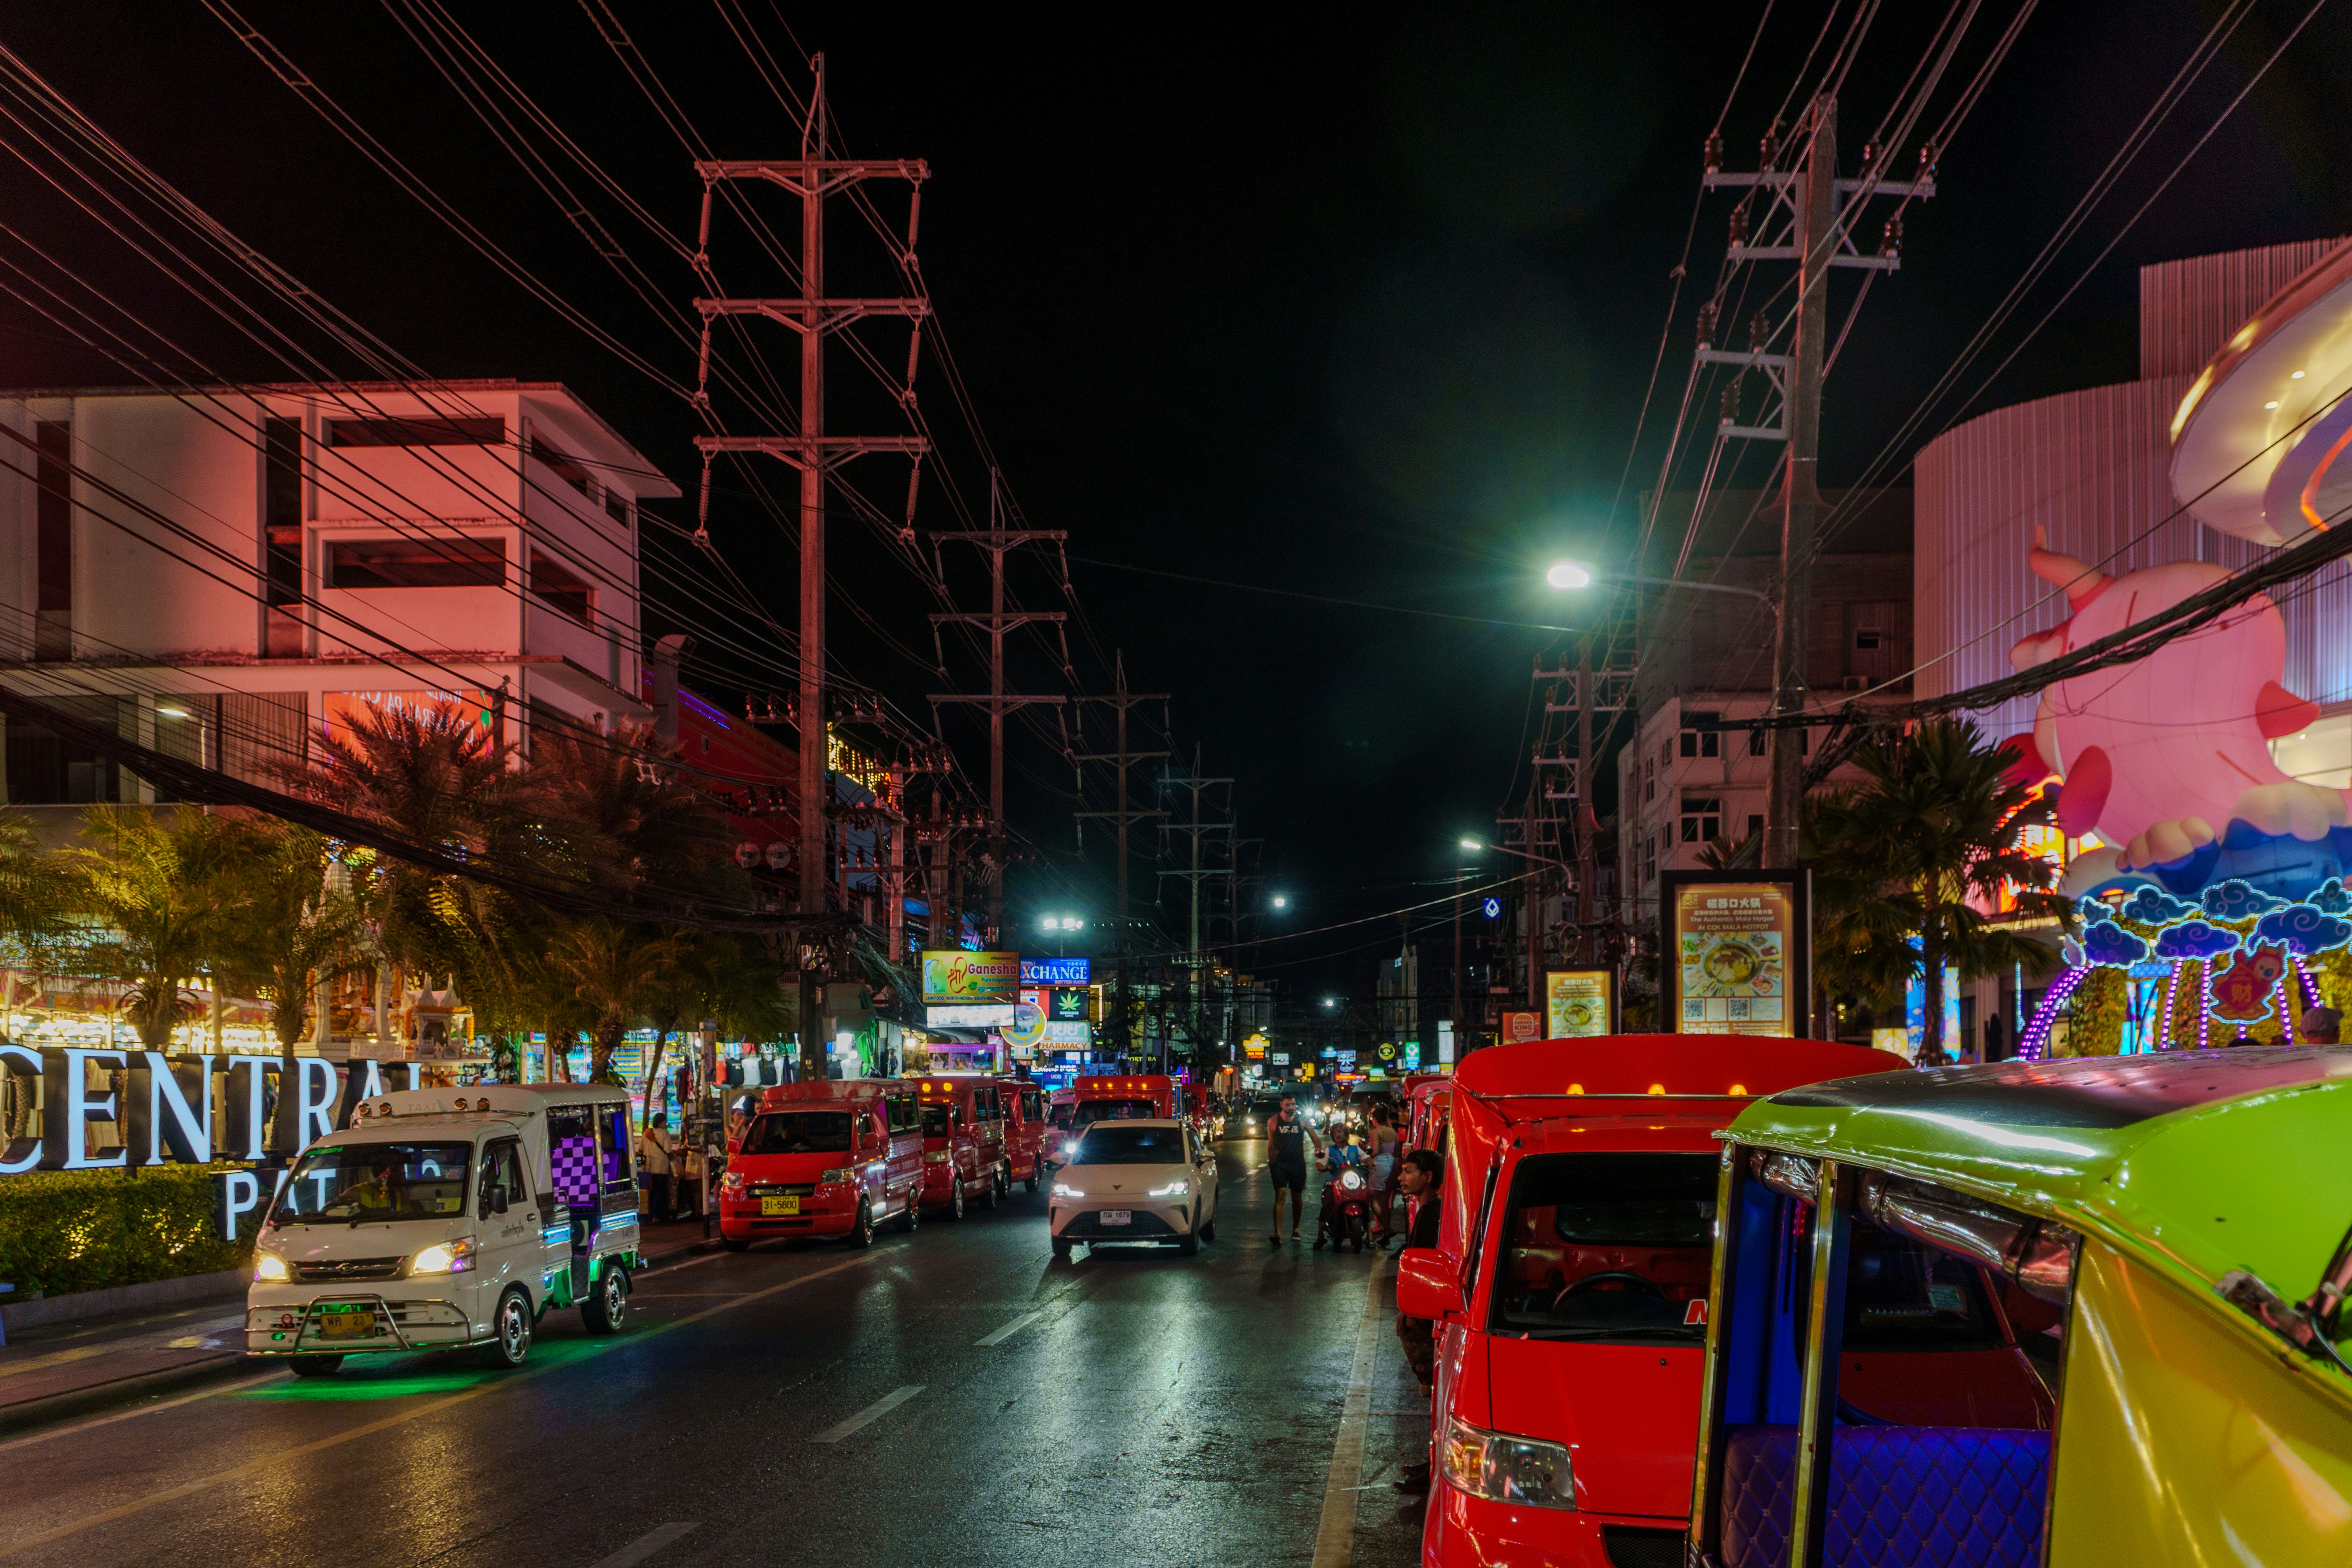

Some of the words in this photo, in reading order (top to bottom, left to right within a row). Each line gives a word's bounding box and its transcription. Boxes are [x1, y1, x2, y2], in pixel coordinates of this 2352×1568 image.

[968, 963, 1017, 975] Ganesha
[1020, 966, 1087, 979] XCHANGE
[408, 1103, 436, 1112] TAXI
